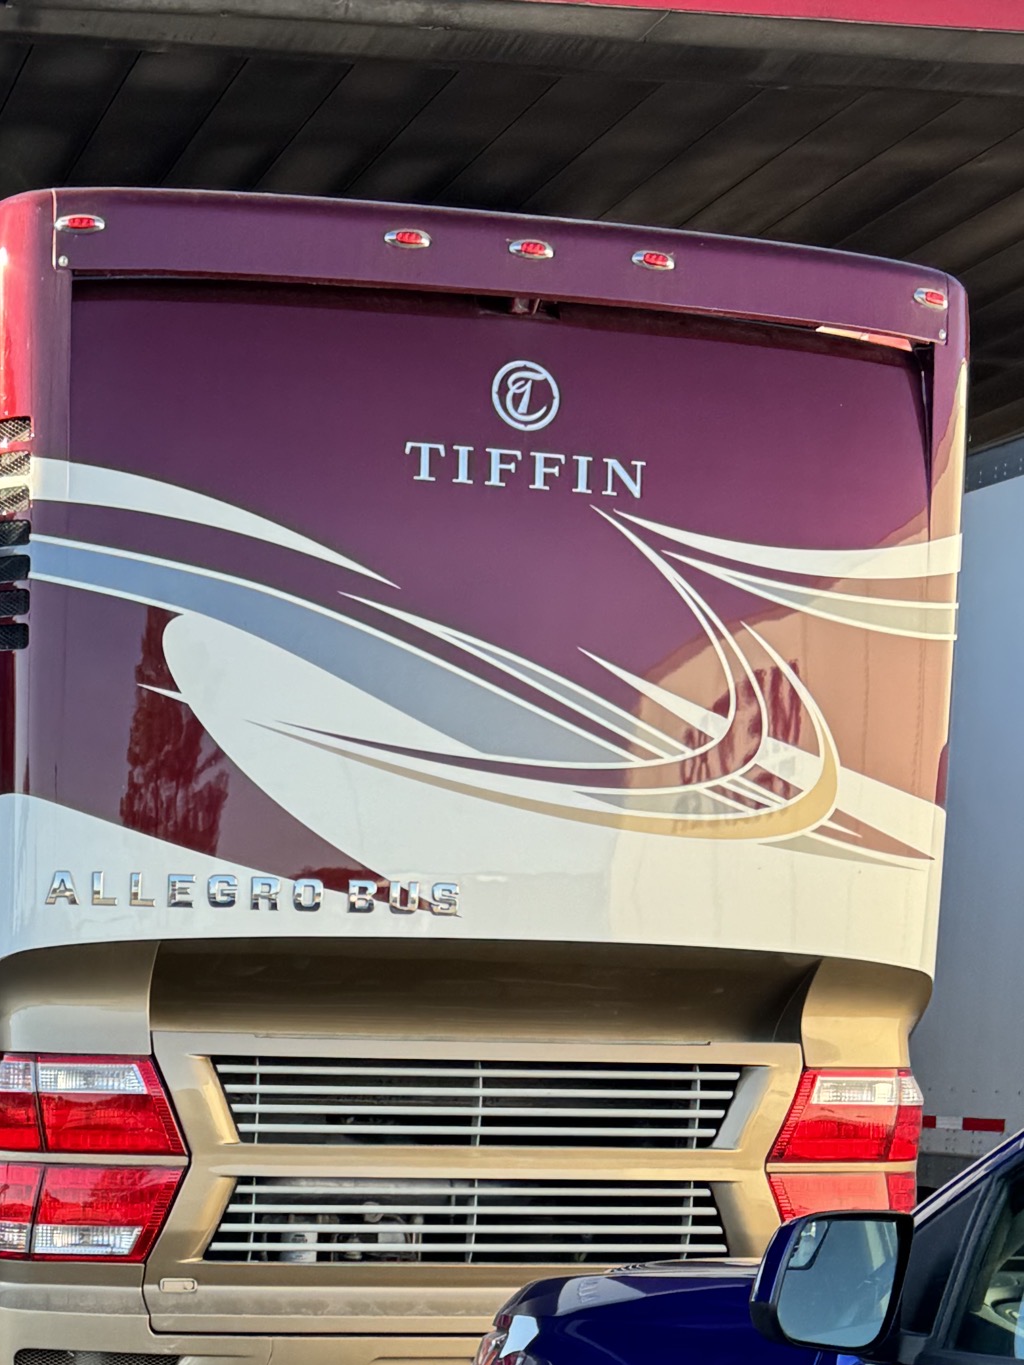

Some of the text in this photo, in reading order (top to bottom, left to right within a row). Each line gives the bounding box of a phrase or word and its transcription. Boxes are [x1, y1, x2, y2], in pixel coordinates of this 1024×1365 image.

[404, 441, 647, 499] TIFFIN
[45, 869, 462, 918] ALLEGRO BUS
